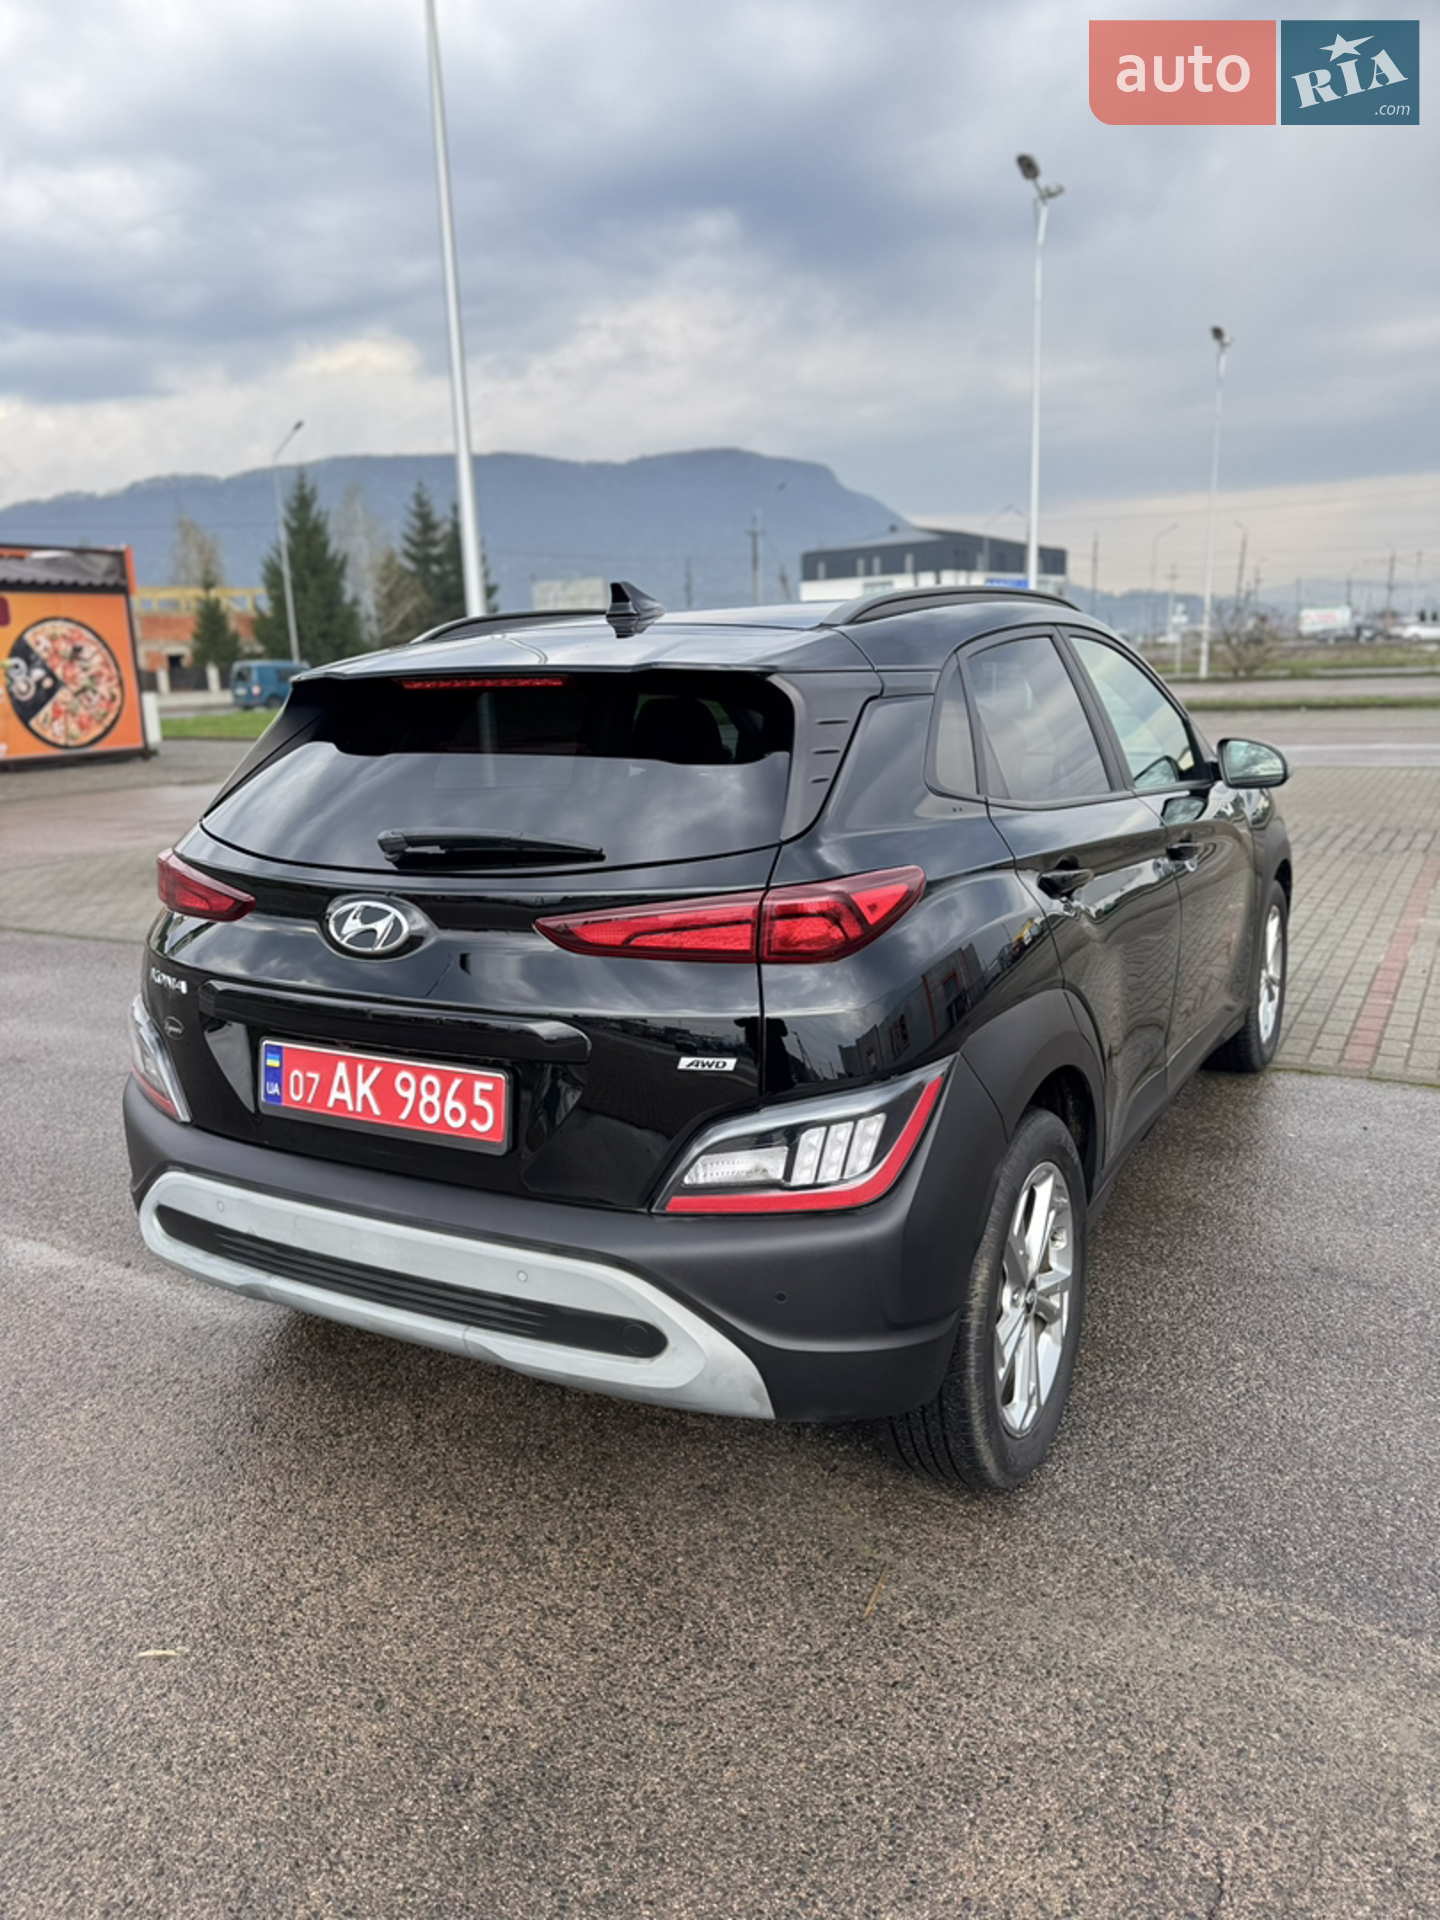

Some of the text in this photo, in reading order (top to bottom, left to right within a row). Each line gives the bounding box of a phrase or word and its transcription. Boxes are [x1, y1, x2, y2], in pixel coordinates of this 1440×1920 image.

[685, 1059, 729, 1070] AWD
[266, 1082, 280, 1095] UA
[289, 1061, 494, 1132] 07 AK 9865
